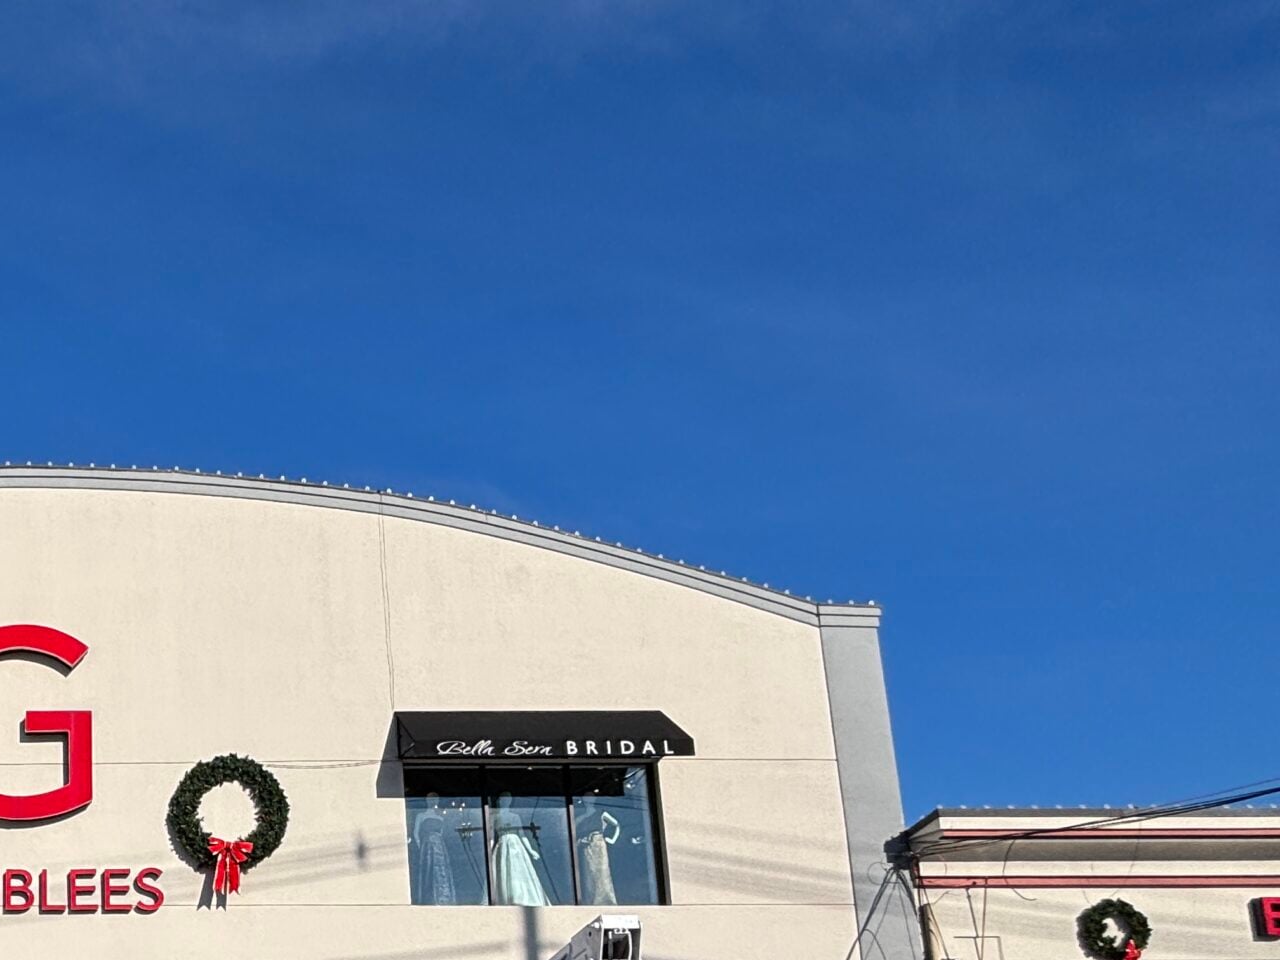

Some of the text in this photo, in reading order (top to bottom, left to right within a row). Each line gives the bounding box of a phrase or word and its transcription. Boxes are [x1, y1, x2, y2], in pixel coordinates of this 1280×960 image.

[436, 740, 675, 756] Bella Sera BRIDAL
